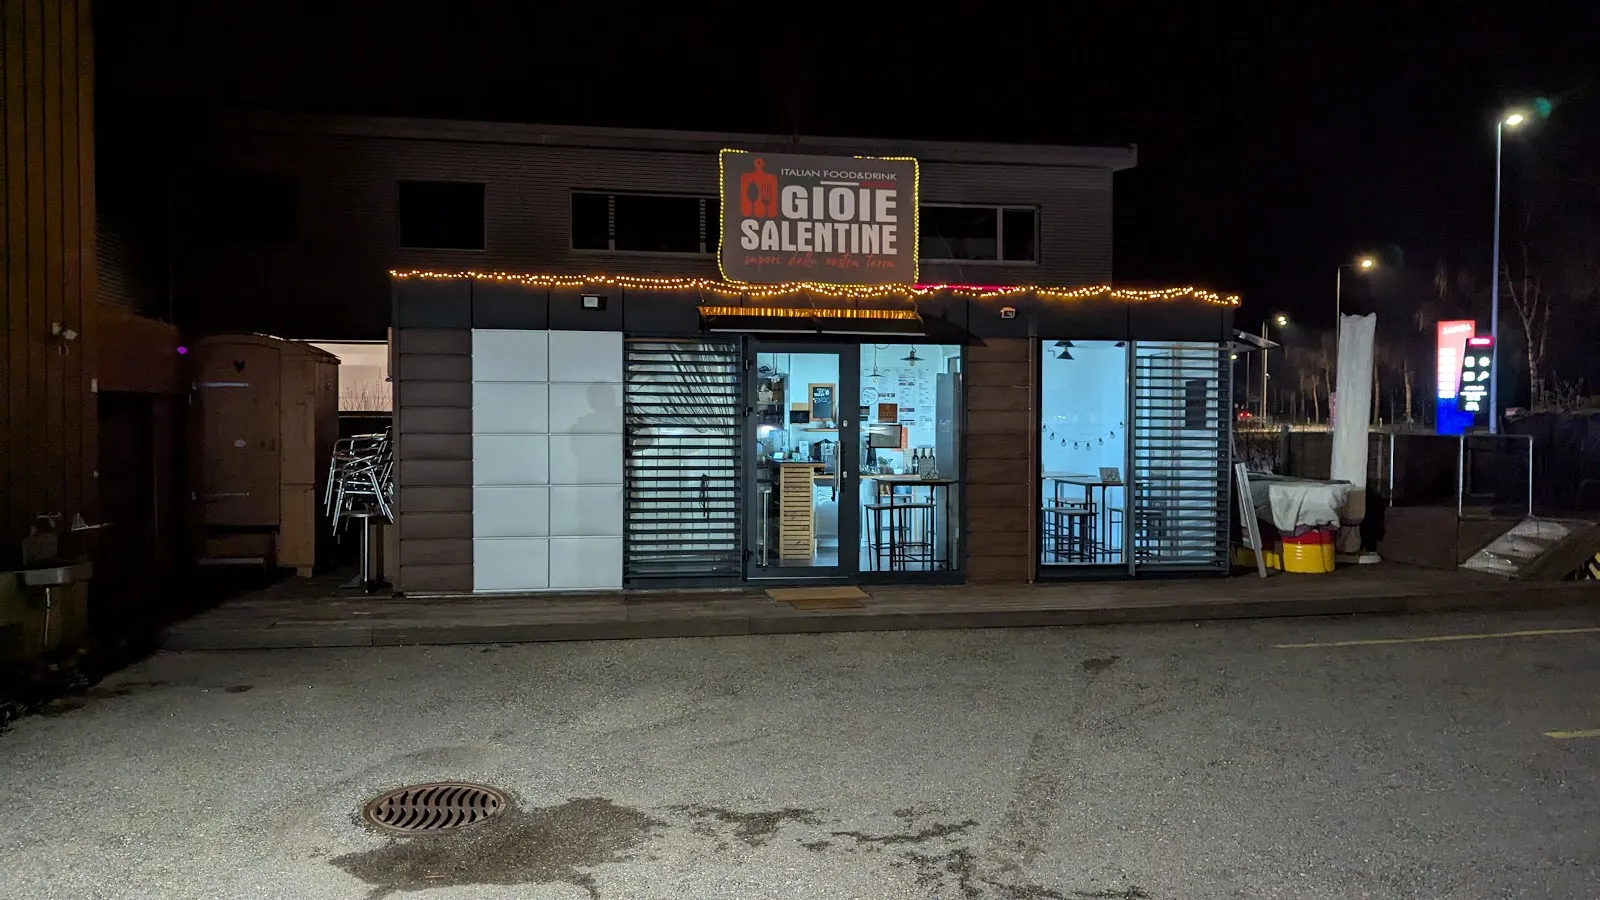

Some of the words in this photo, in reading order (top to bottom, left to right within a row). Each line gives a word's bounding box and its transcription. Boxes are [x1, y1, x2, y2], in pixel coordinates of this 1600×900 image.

[781, 168, 820, 177] ITALIAN
[823, 170, 897, 180] FOOD&DRINK
[781, 185, 897, 222] GIOIE
[740, 219, 897, 254] SALENTINE
